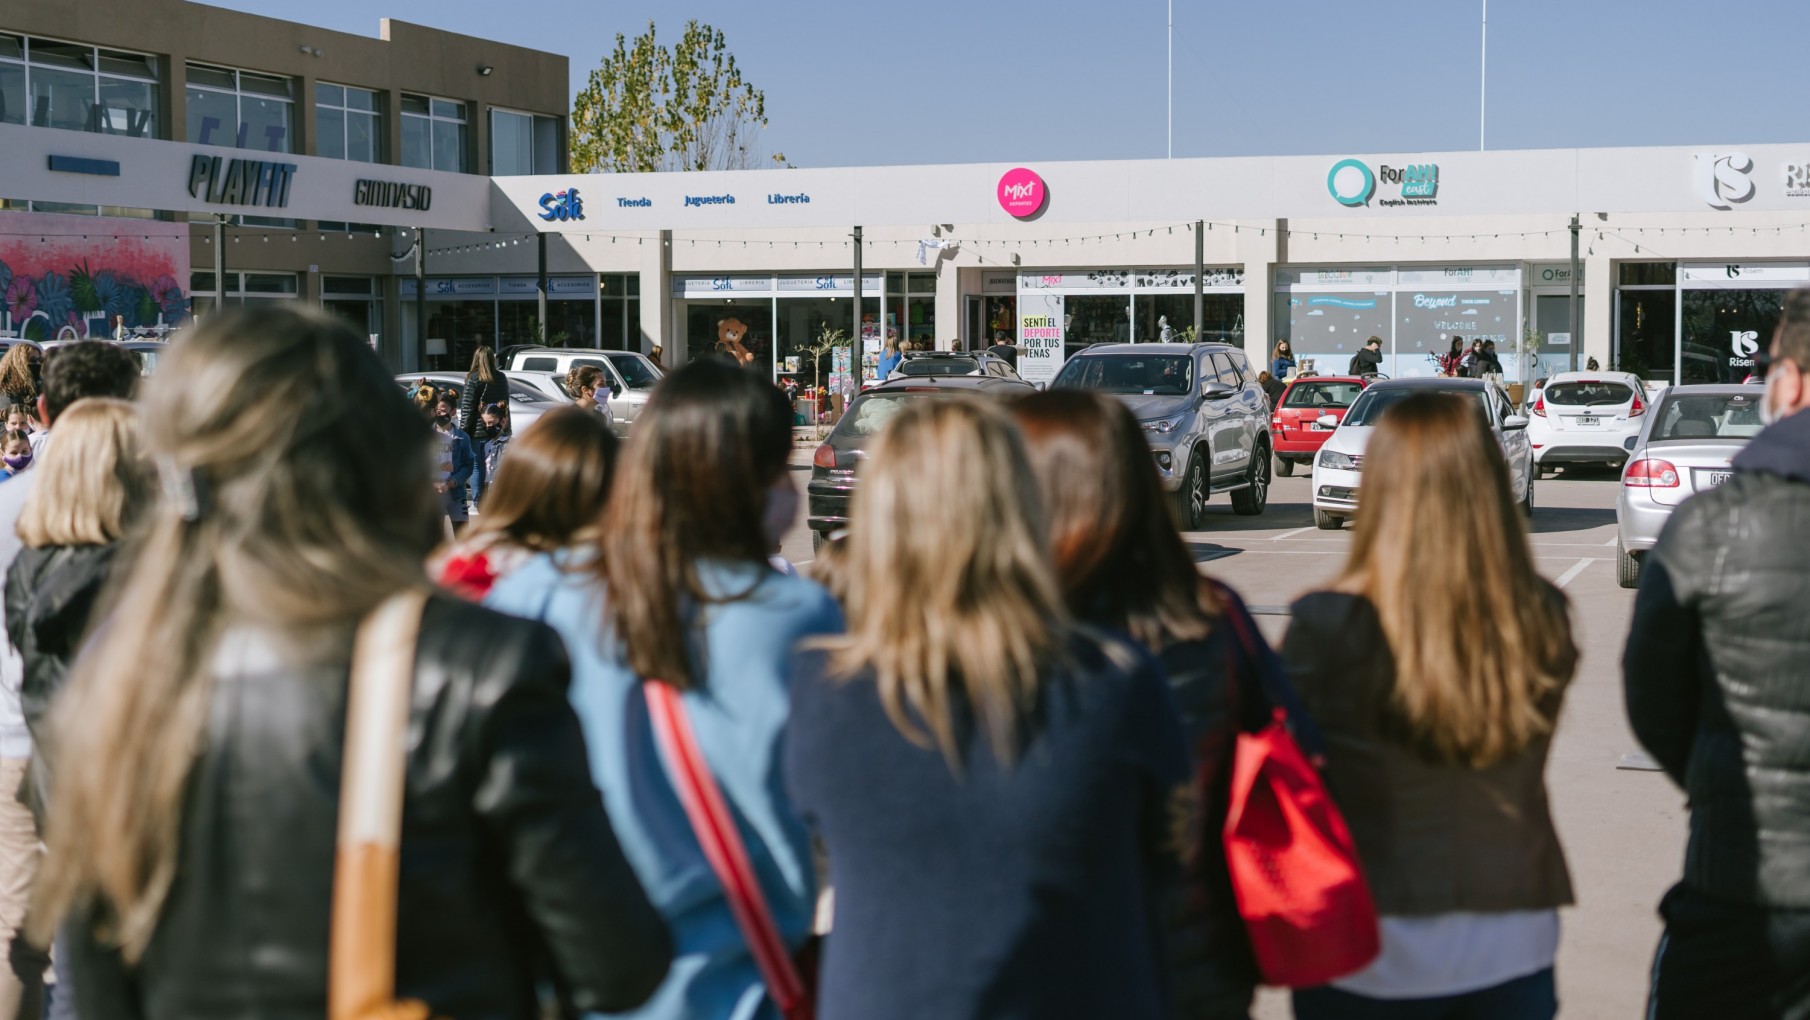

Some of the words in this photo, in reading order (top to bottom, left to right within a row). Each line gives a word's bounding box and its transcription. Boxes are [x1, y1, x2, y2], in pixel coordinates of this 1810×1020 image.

[189, 154, 298, 208] PLAYFIT
[1406, 183, 1430, 194] east
[354, 179, 431, 211] GIMNASIO
[684, 194, 736, 207] Juguetería
[767, 193, 810, 204] Librería
[617, 197, 652, 207] Tienda
[1380, 199, 1406, 207] English
[1414, 293, 1457, 309] Beyond
[1024, 315, 1046, 327] SENTÍ
[1048, 318, 1056, 327] EL
[1024, 328, 1060, 337] DEPORTE
[1024, 338, 1041, 348] POR
[1044, 338, 1059, 347] TUS
[1729, 357, 1755, 367] Risen
